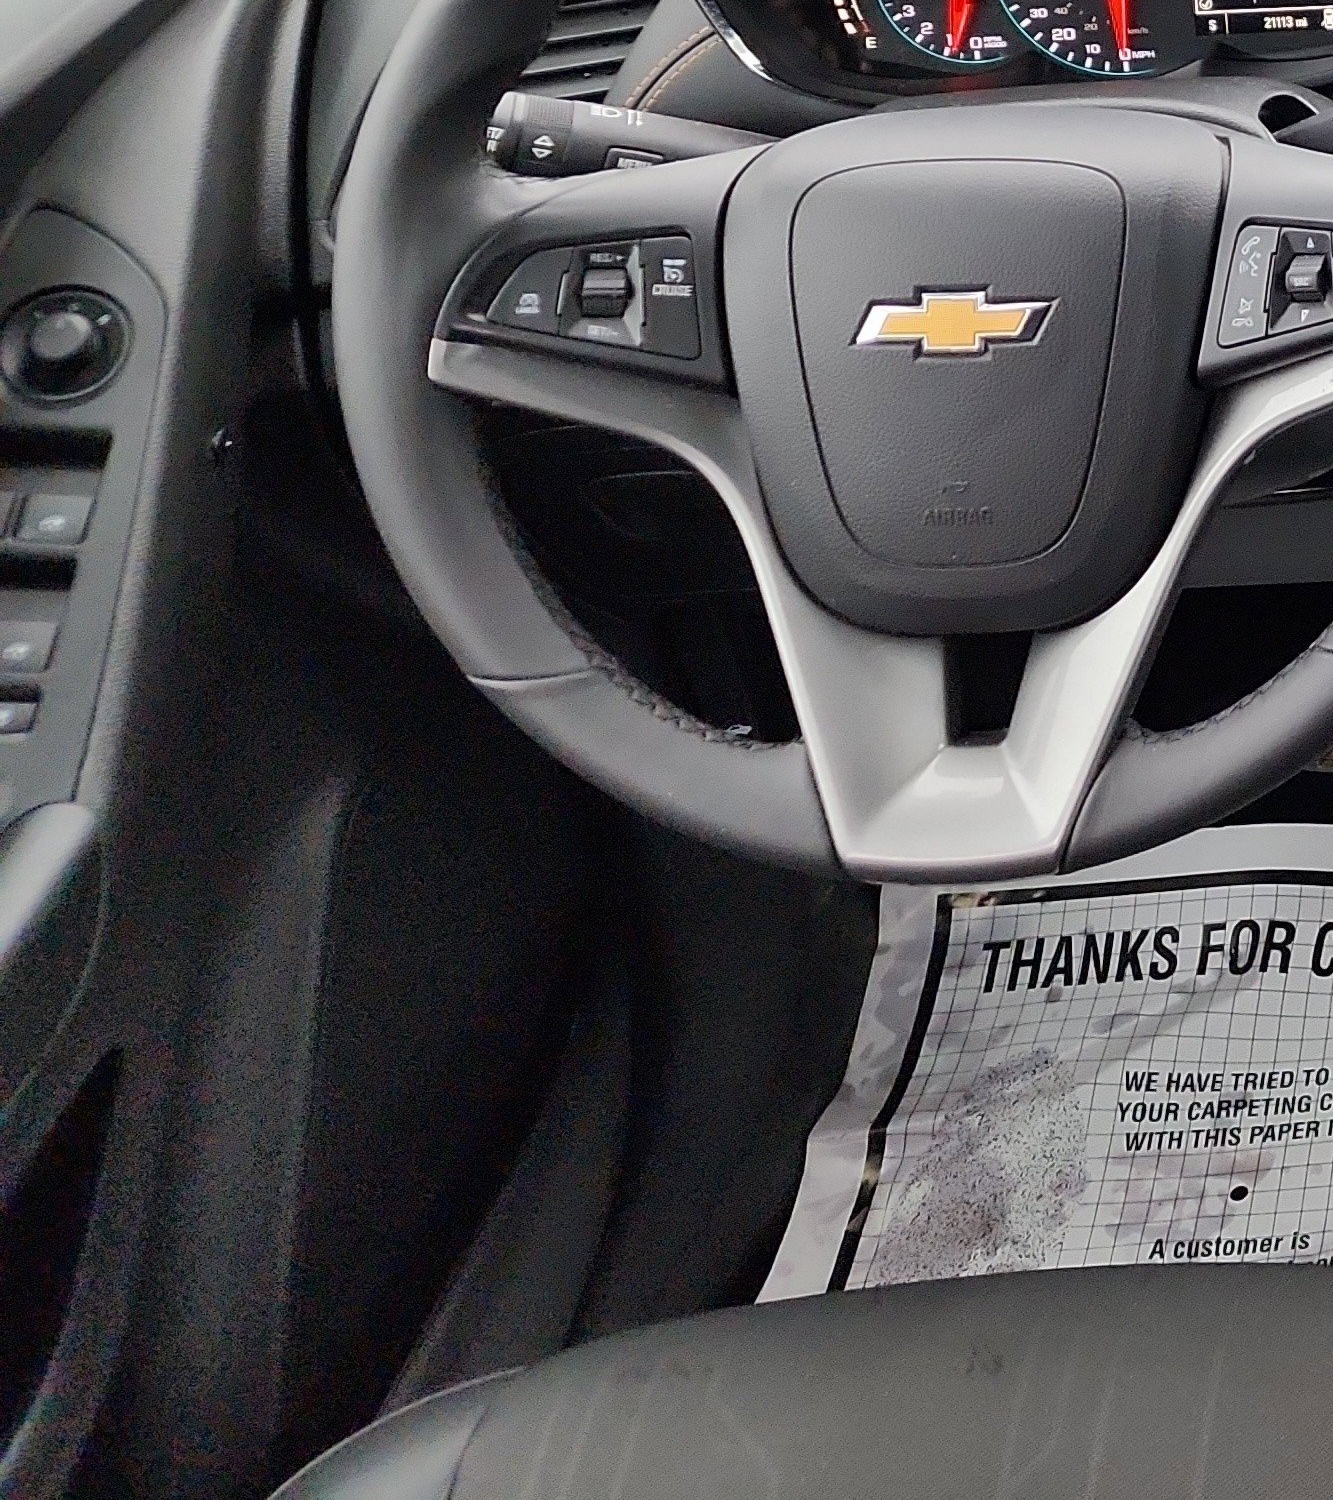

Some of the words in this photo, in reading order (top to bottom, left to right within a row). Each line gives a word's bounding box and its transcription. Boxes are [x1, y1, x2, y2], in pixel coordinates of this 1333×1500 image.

[902, 4, 916, 17] 3
[1029, 8, 1048, 19] 30
[920, 22, 934, 35] 2
[1263, 16, 1294, 29] 21113
[1052, 28, 1076, 41] 20
[865, 36, 877, 49] E
[969, 36, 983, 49] 0
[1085, 44, 1100, 54] 10
[1132, 50, 1156, 59] MPH
[982, 925, 1179, 993] THANKS
[1196, 919, 1296, 976] FOR
[1124, 1071, 1160, 1092] WE
[1166, 1071, 1224, 1092] HAVE
[1231, 1070, 1295, 1091] TRIED
[1302, 1067, 1330, 1087] TO
[1117, 1101, 1180, 1123] YOUR
[1187, 1095, 1312, 1122] CARPETING
[1125, 1130, 1183, 1152] WITH
[1191, 1127, 1242, 1149] THIS
[1249, 1119, 1320, 1145] PAPER
[1148, 1239, 1166, 1260] A
[1173, 1234, 1284, 1260] customer
[1290, 1231, 1311, 1251] is
